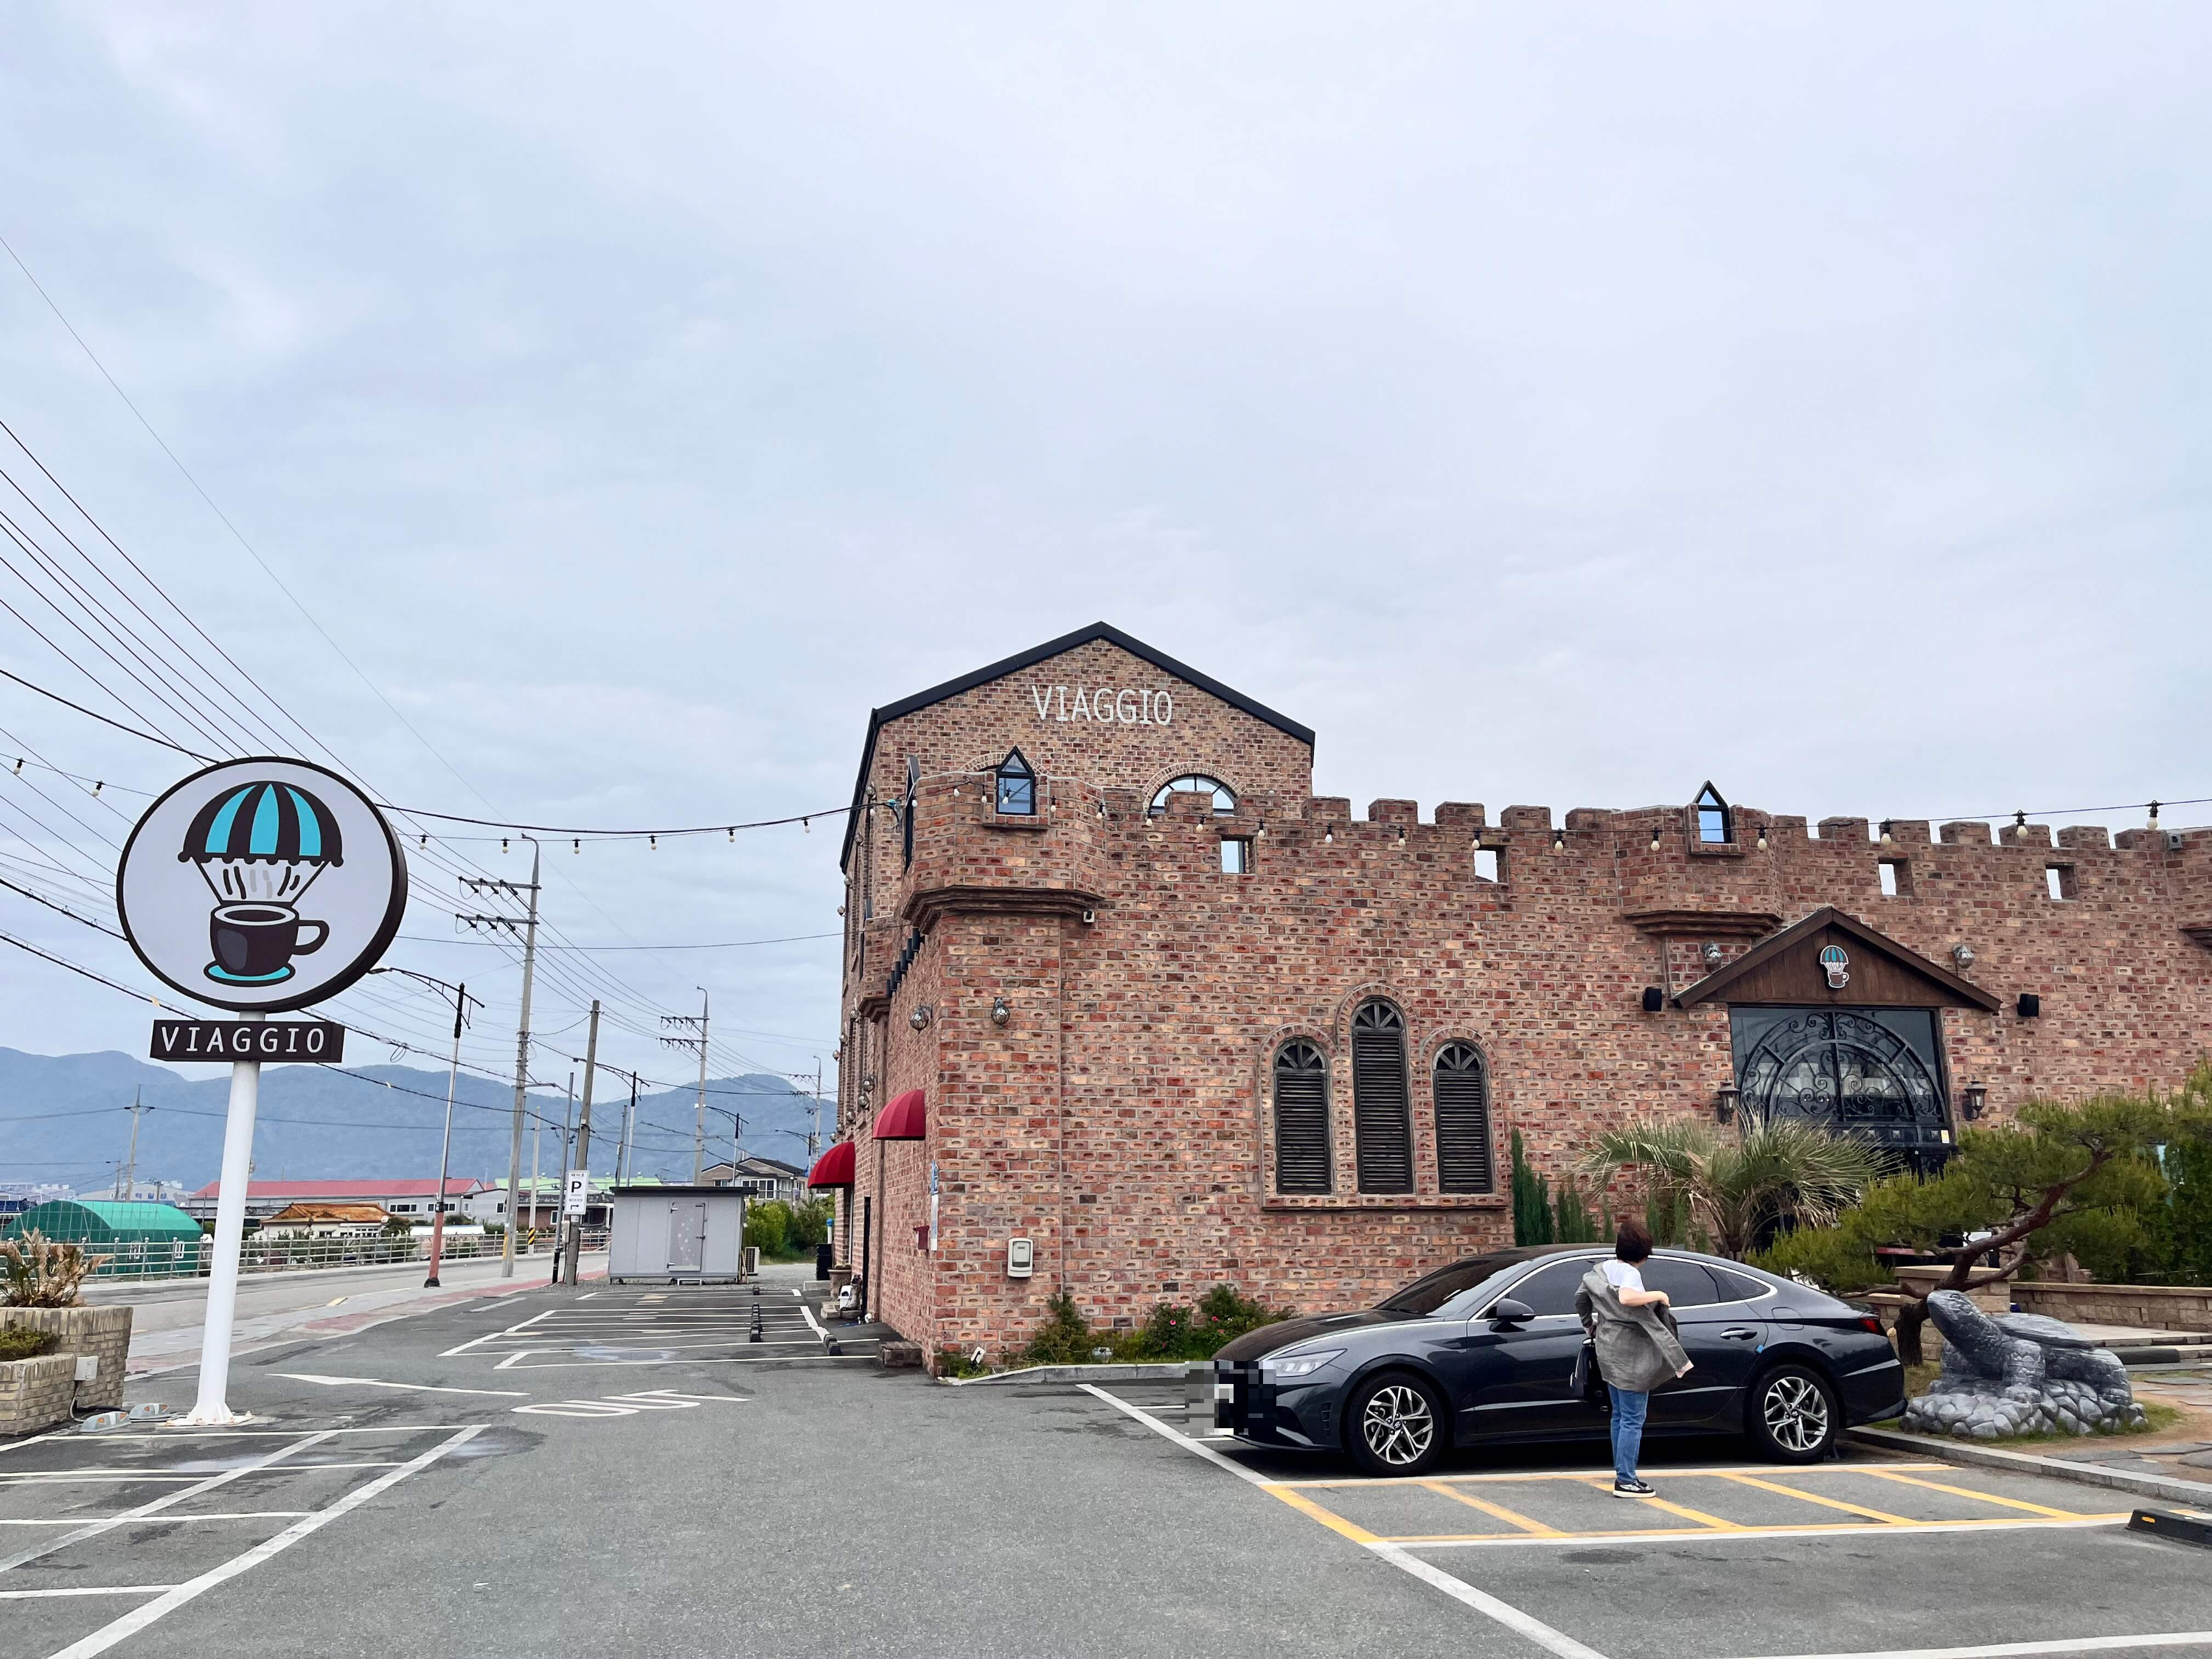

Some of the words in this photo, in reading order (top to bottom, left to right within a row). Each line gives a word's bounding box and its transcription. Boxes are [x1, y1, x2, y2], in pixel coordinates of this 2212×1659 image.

[1032, 685, 1172, 726] VIAGGIO
[161, 1026, 324, 1054] VIAGGIO
[571, 1180, 582, 1193] P
